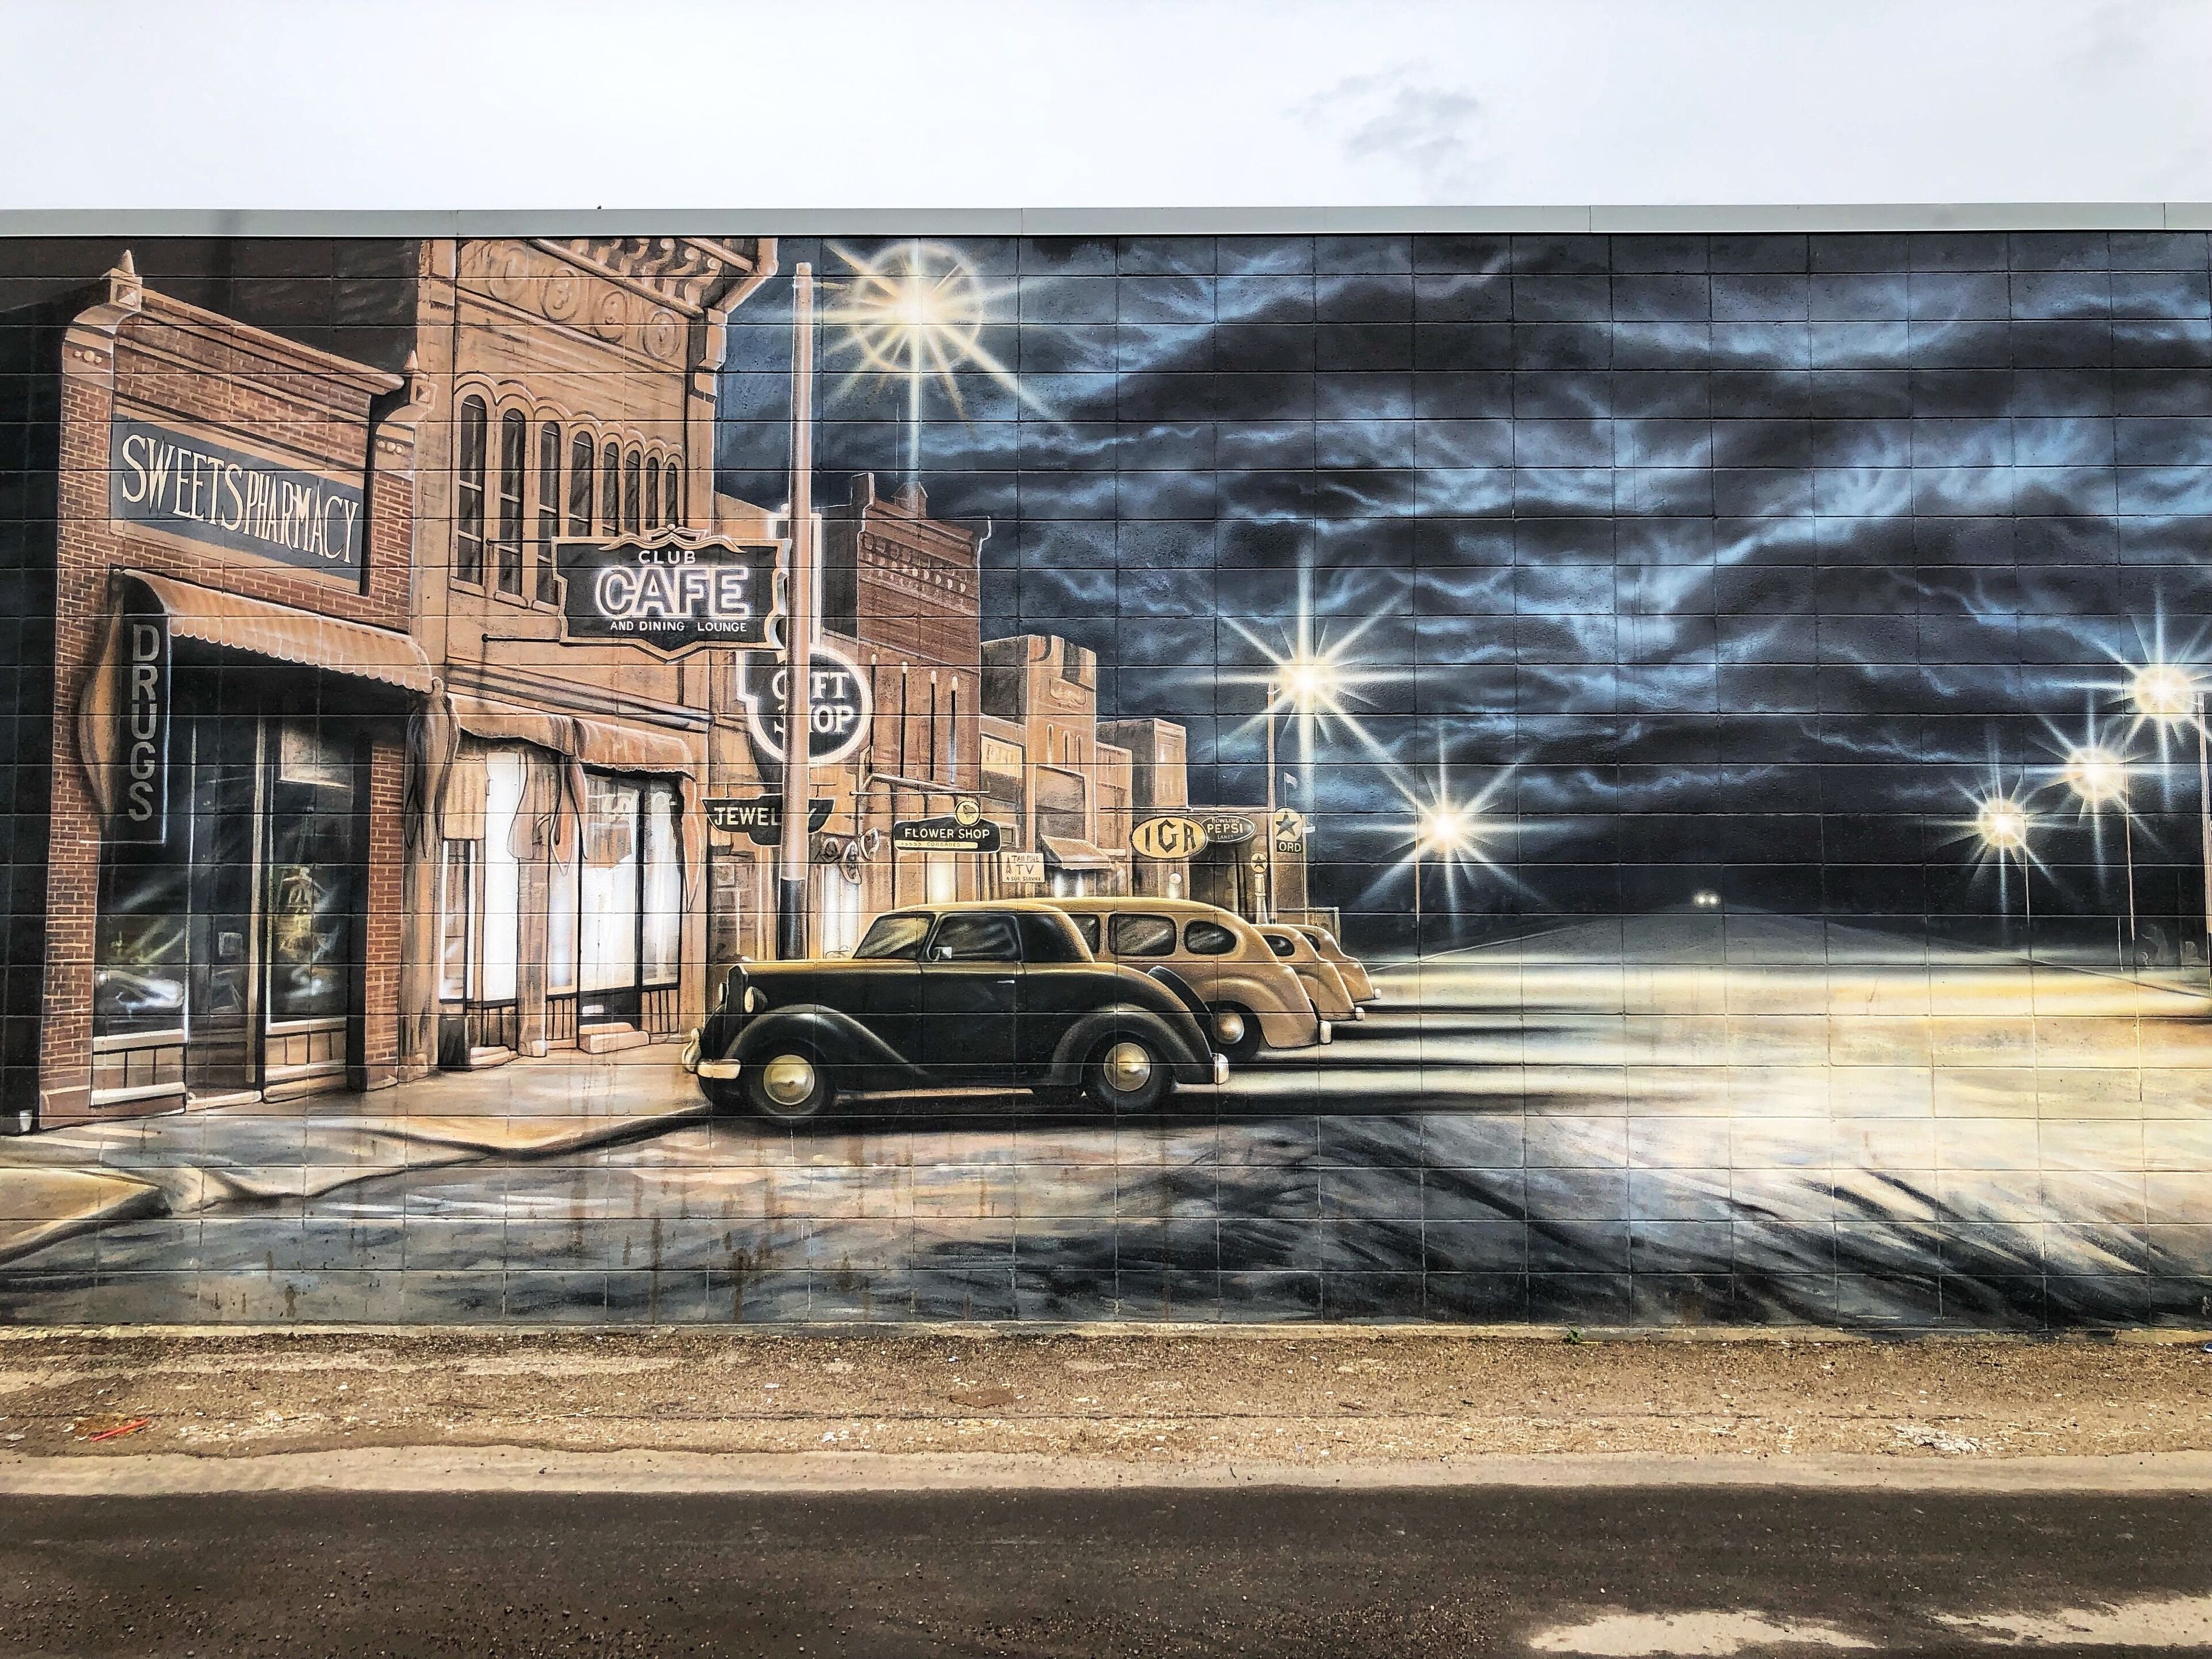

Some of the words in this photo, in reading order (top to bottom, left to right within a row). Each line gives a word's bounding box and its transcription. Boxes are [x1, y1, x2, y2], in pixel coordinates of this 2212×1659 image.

[122, 434, 245, 531] SWEETS
[243, 471, 359, 564] PHARMACY
[638, 550, 696, 565] CLUB
[595, 565, 749, 620] CAFE
[610, 621, 634, 631] AND
[639, 621, 685, 632] DINING
[698, 622, 747, 632] LOUNGE
[128, 624, 160, 821] DRUGS
[774, 704, 854, 734] SOP
[904, 828, 955, 839] FLOWER
[958, 828, 990, 839] SHOP
[1145, 819, 1198, 854] IGA
[1207, 823, 1244, 834] PEPSI
[1015, 865, 1035, 875] TV
